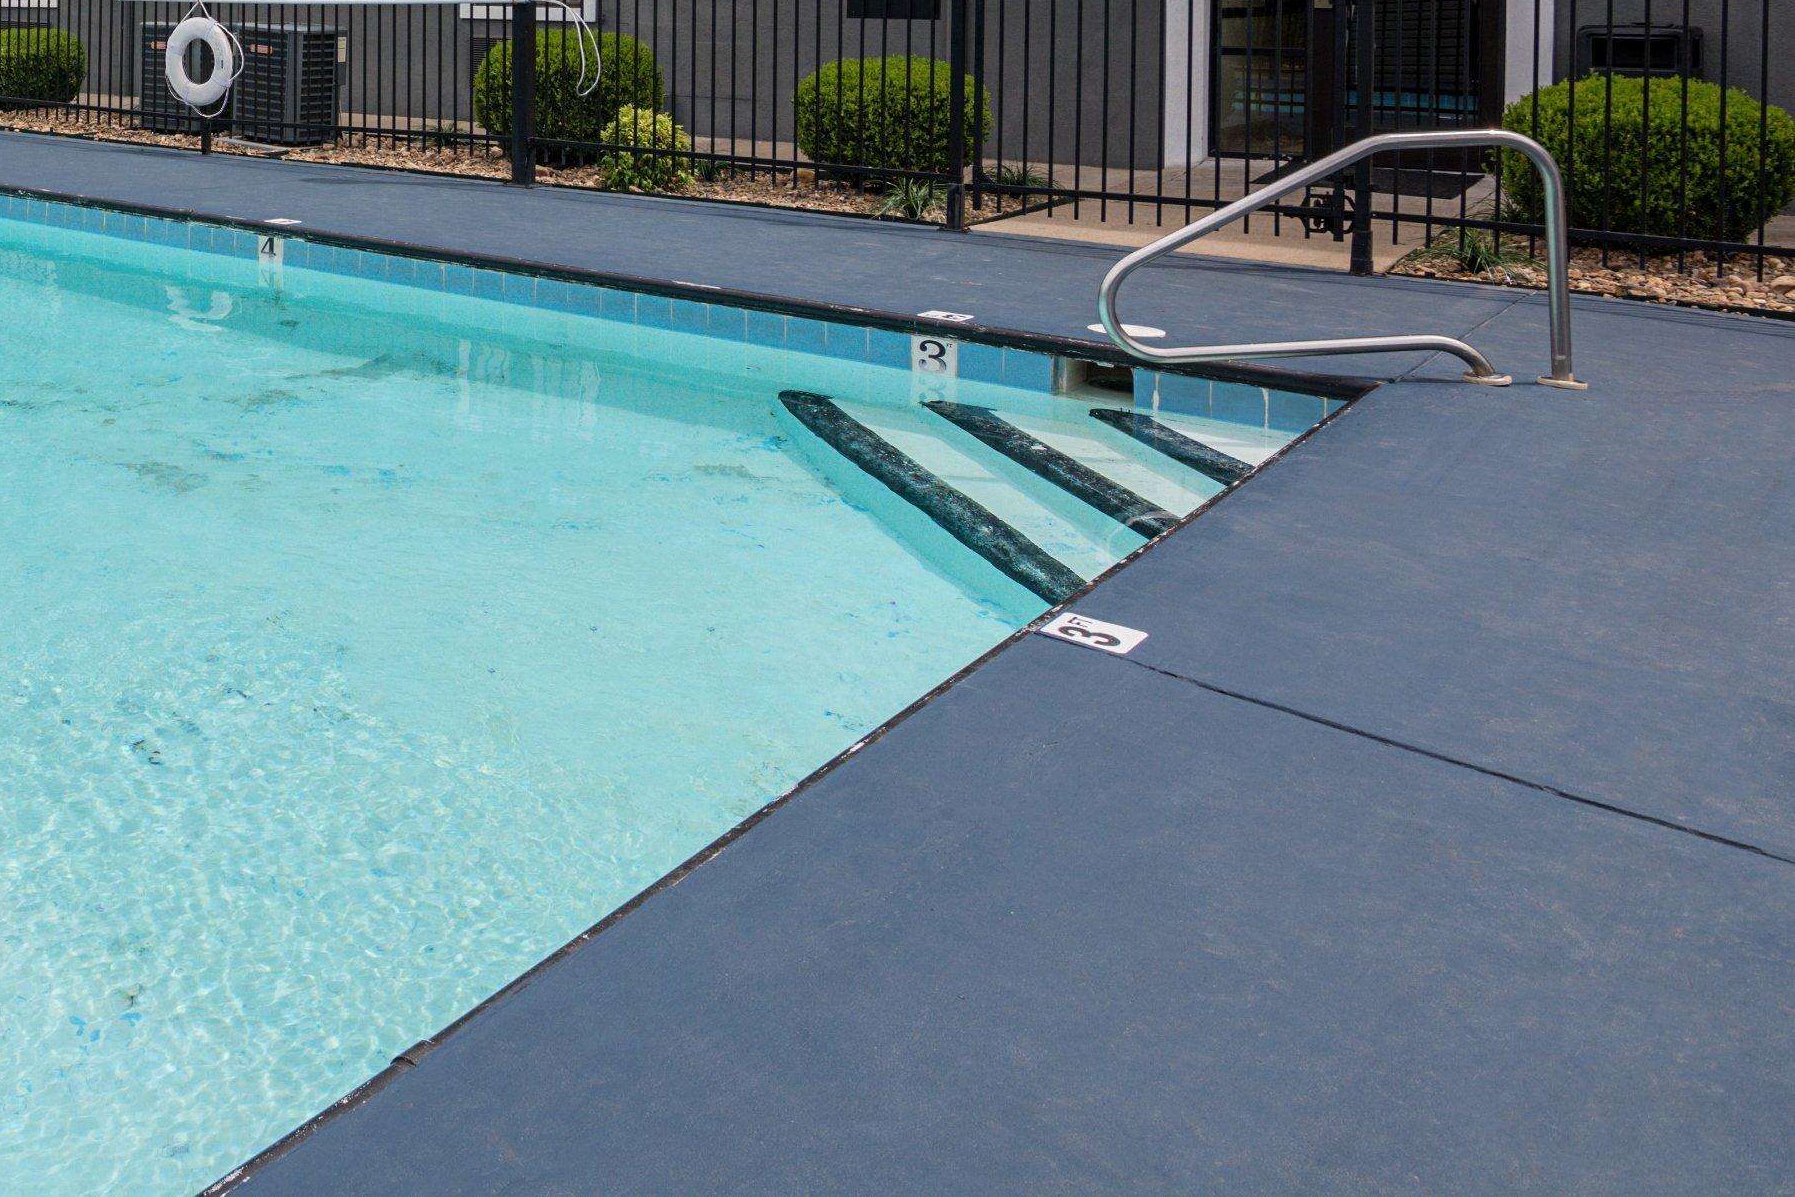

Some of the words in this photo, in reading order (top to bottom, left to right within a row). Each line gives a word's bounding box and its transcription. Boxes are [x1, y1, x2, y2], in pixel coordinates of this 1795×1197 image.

[260, 236, 276, 258] 4
[919, 339, 947, 372] 3
[1058, 625, 1121, 647] 3
